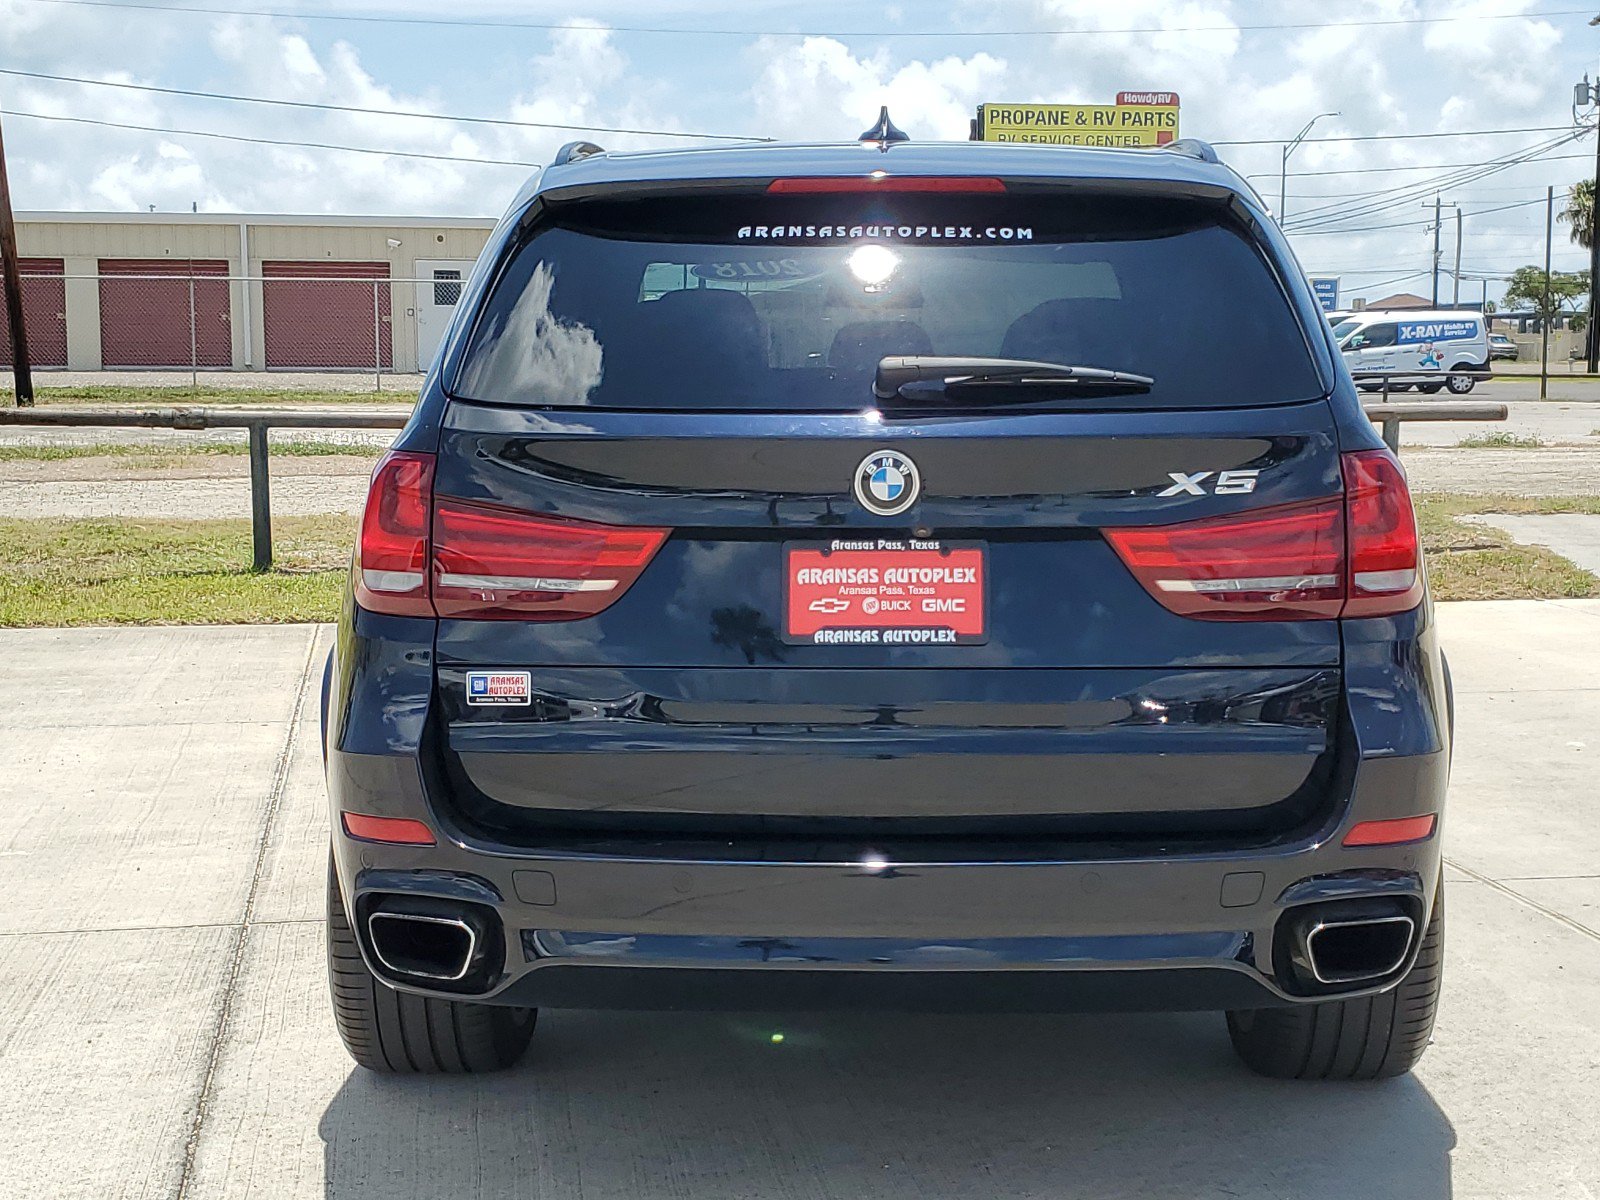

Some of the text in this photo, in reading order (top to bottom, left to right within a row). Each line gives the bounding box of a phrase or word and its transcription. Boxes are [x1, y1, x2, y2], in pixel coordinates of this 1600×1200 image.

[1124, 93, 1171, 104] HowdyRV
[990, 110, 1175, 126] PROPANE & RV PARTS
[998, 134, 1141, 146] RV SERVICE CENTER
[738, 226, 1033, 239] ARANSASAUTOPLEX.COM
[1400, 324, 1443, 339] X-RAY
[865, 457, 910, 476] BMW
[1156, 469, 1260, 497] X5
[831, 540, 940, 551] Aransas Pass, Texas
[797, 567, 976, 585] ARANSAS AUTOPLEX
[838, 586, 936, 596] Aransas Pass, Texas
[880, 599, 965, 612] BUICK GMC
[814, 630, 957, 643] ARANSAS AUTOPLEX
[490, 677, 524, 685] ARANSAS
[489, 687, 526, 695] AUTOPLEX
